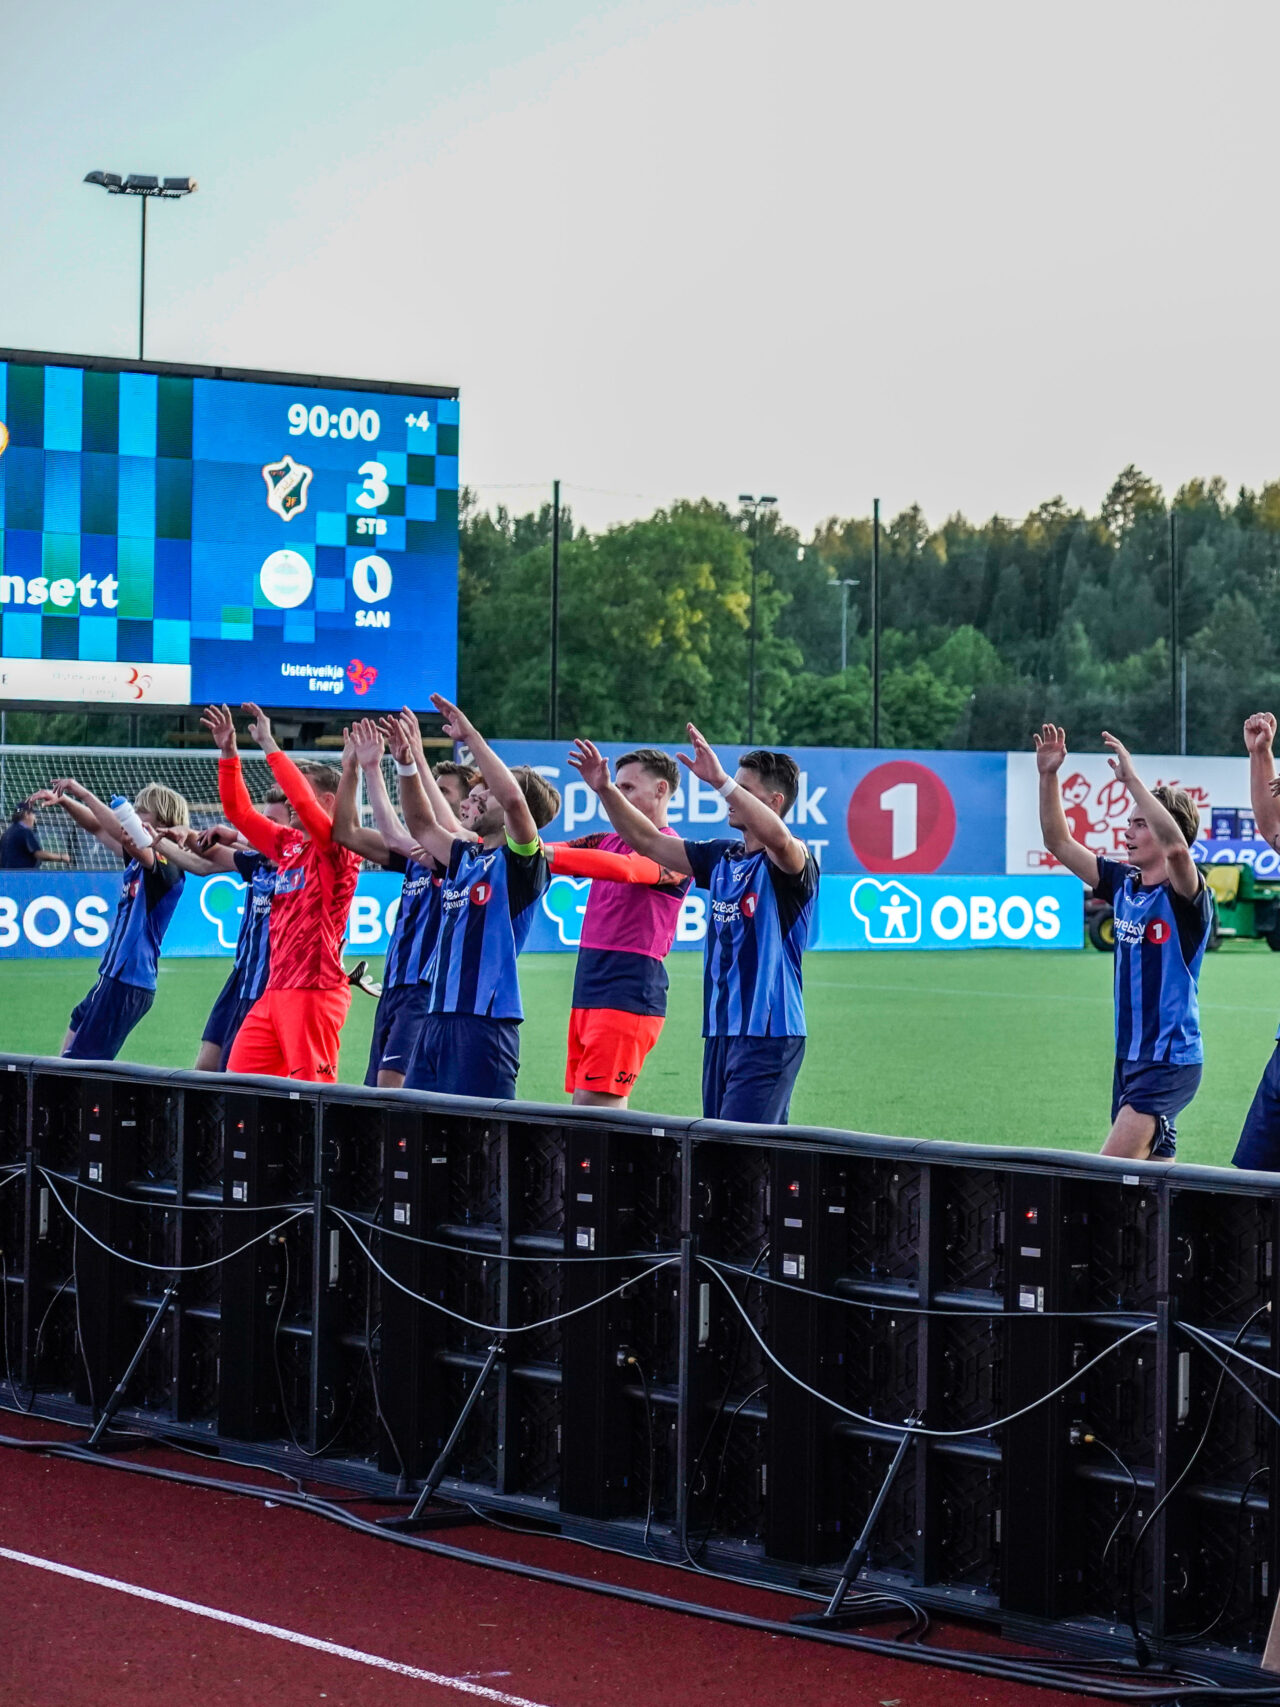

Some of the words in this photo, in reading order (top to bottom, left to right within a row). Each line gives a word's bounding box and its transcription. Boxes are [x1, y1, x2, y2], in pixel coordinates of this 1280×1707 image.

[288, 403, 381, 442] 90:00
[405, 411, 430, 432] +4
[356, 461, 389, 509] 3
[356, 518, 387, 535] STB
[352, 555, 392, 603] 0
[355, 610, 390, 628] SAN
[309, 679, 344, 694] Energi
[880, 783, 917, 860] 1
[476, 886, 485, 901] 1
[746, 897, 755, 913] 1
[931, 895, 1061, 940] OBOS
[1153, 923, 1163, 940] 1
